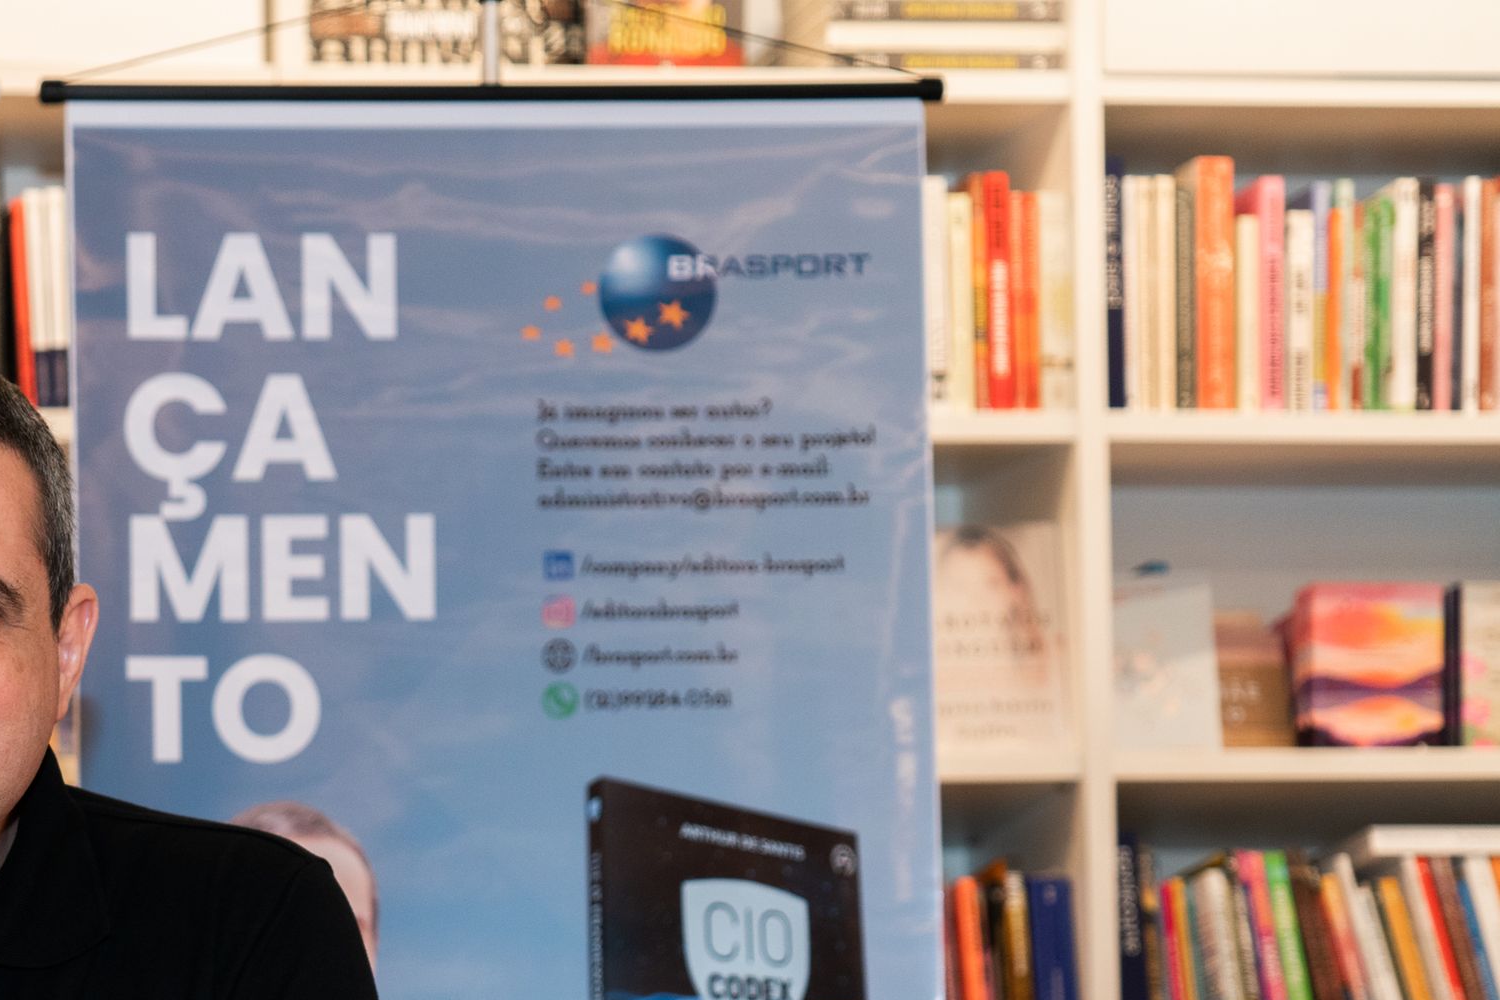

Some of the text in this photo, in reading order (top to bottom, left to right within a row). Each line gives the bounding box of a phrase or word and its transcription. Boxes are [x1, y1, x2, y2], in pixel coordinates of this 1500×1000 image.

[126, 232, 397, 340] LAN
[667, 252, 871, 282] BRASPORT
[123, 372, 338, 522] ÇA
[129, 513, 437, 622] MEN
[125, 653, 321, 764] TO
[703, 901, 794, 968] CIO
